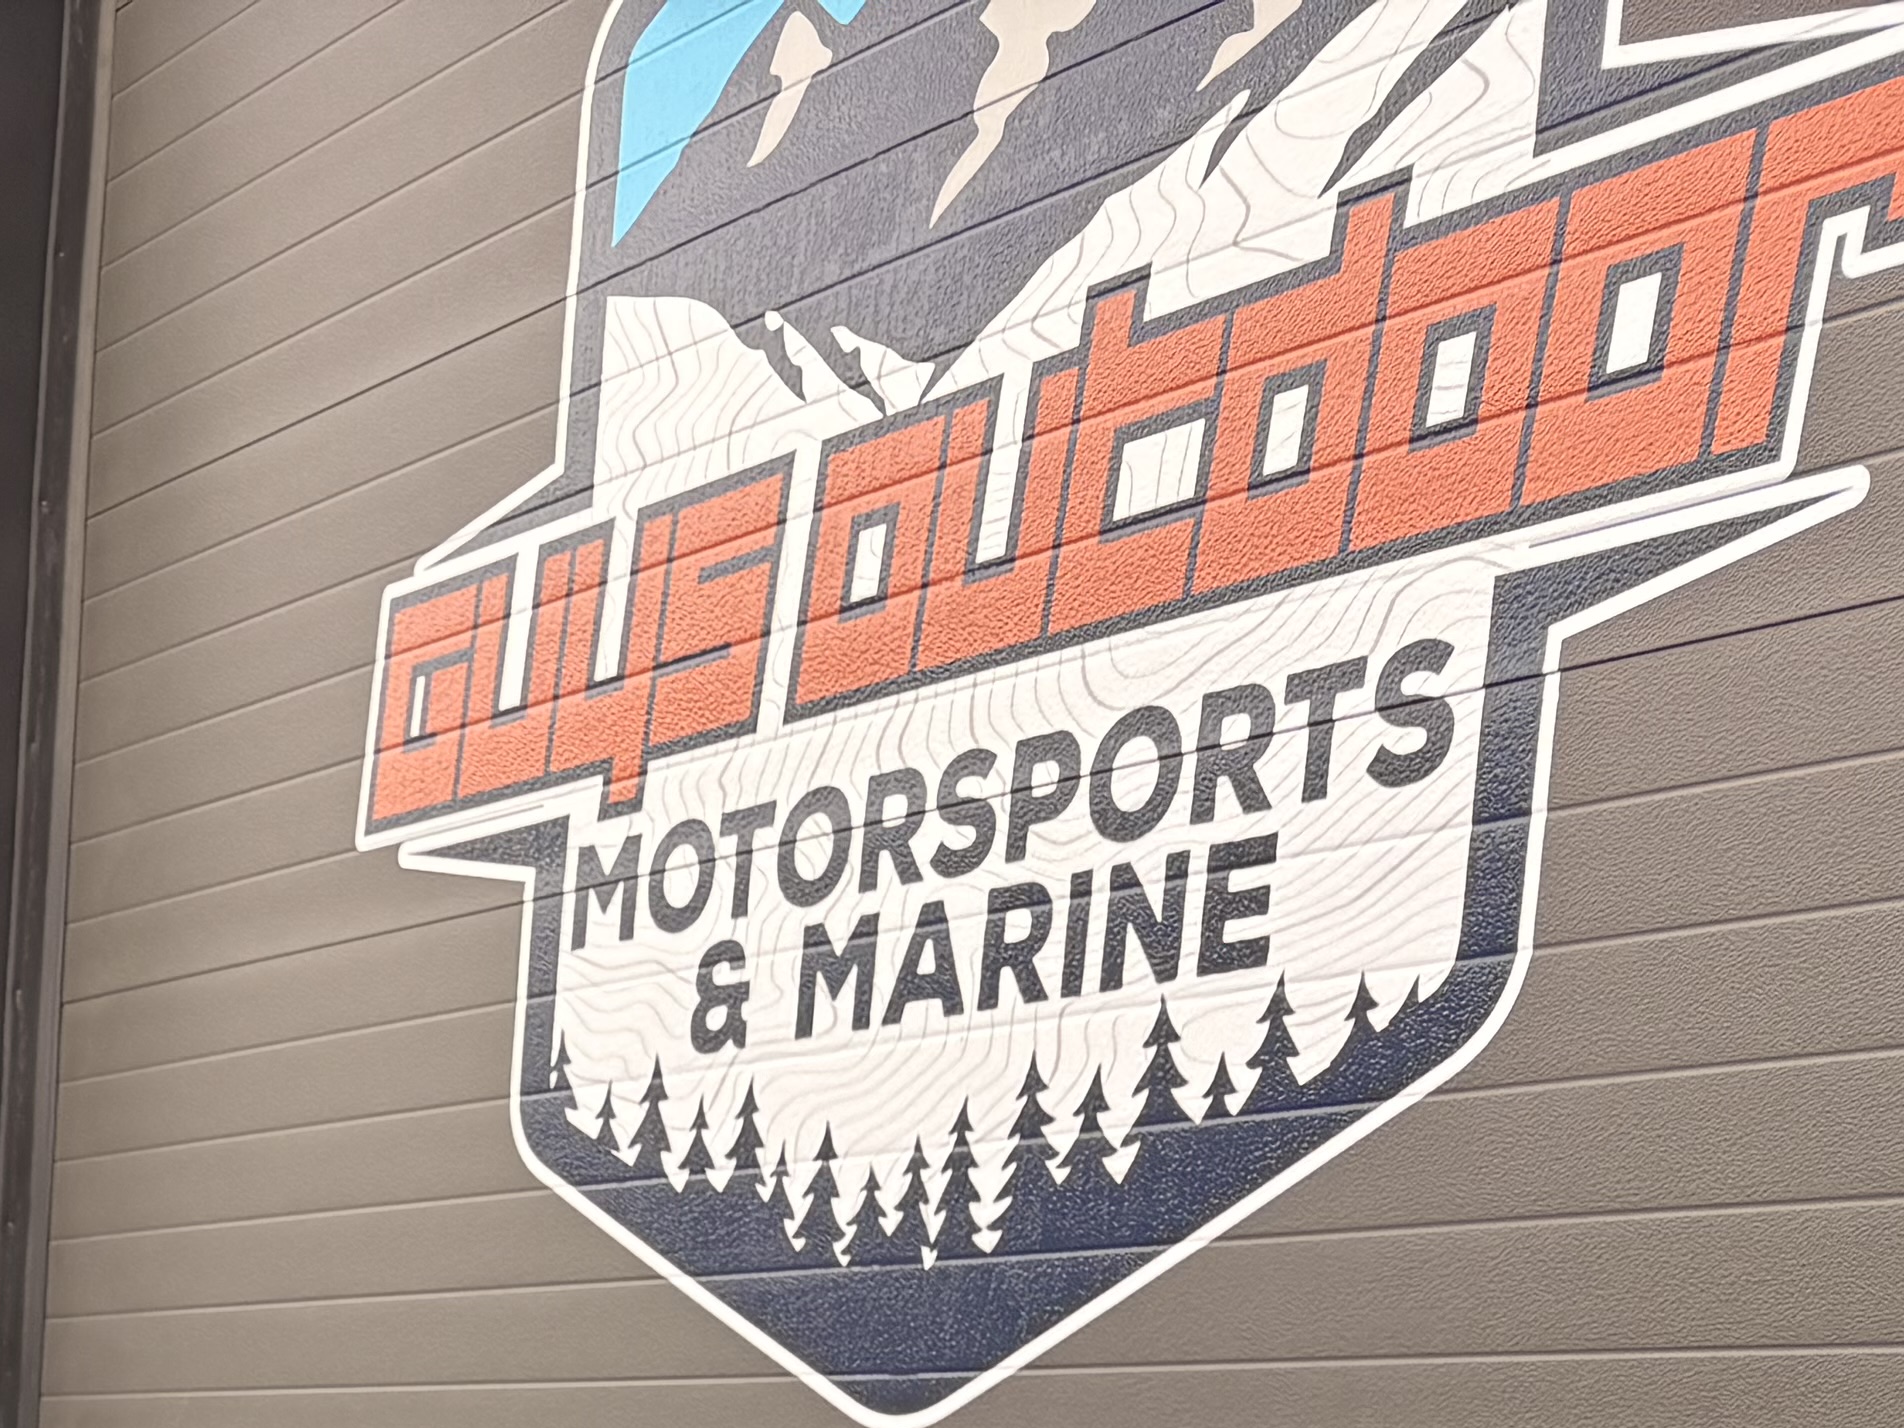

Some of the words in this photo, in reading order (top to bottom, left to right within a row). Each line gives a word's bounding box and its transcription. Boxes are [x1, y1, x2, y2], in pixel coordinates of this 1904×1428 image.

[570, 637, 1456, 951] MOTORSPORTS
[688, 938, 752, 1055] &
[794, 831, 1280, 1041] MARINE
